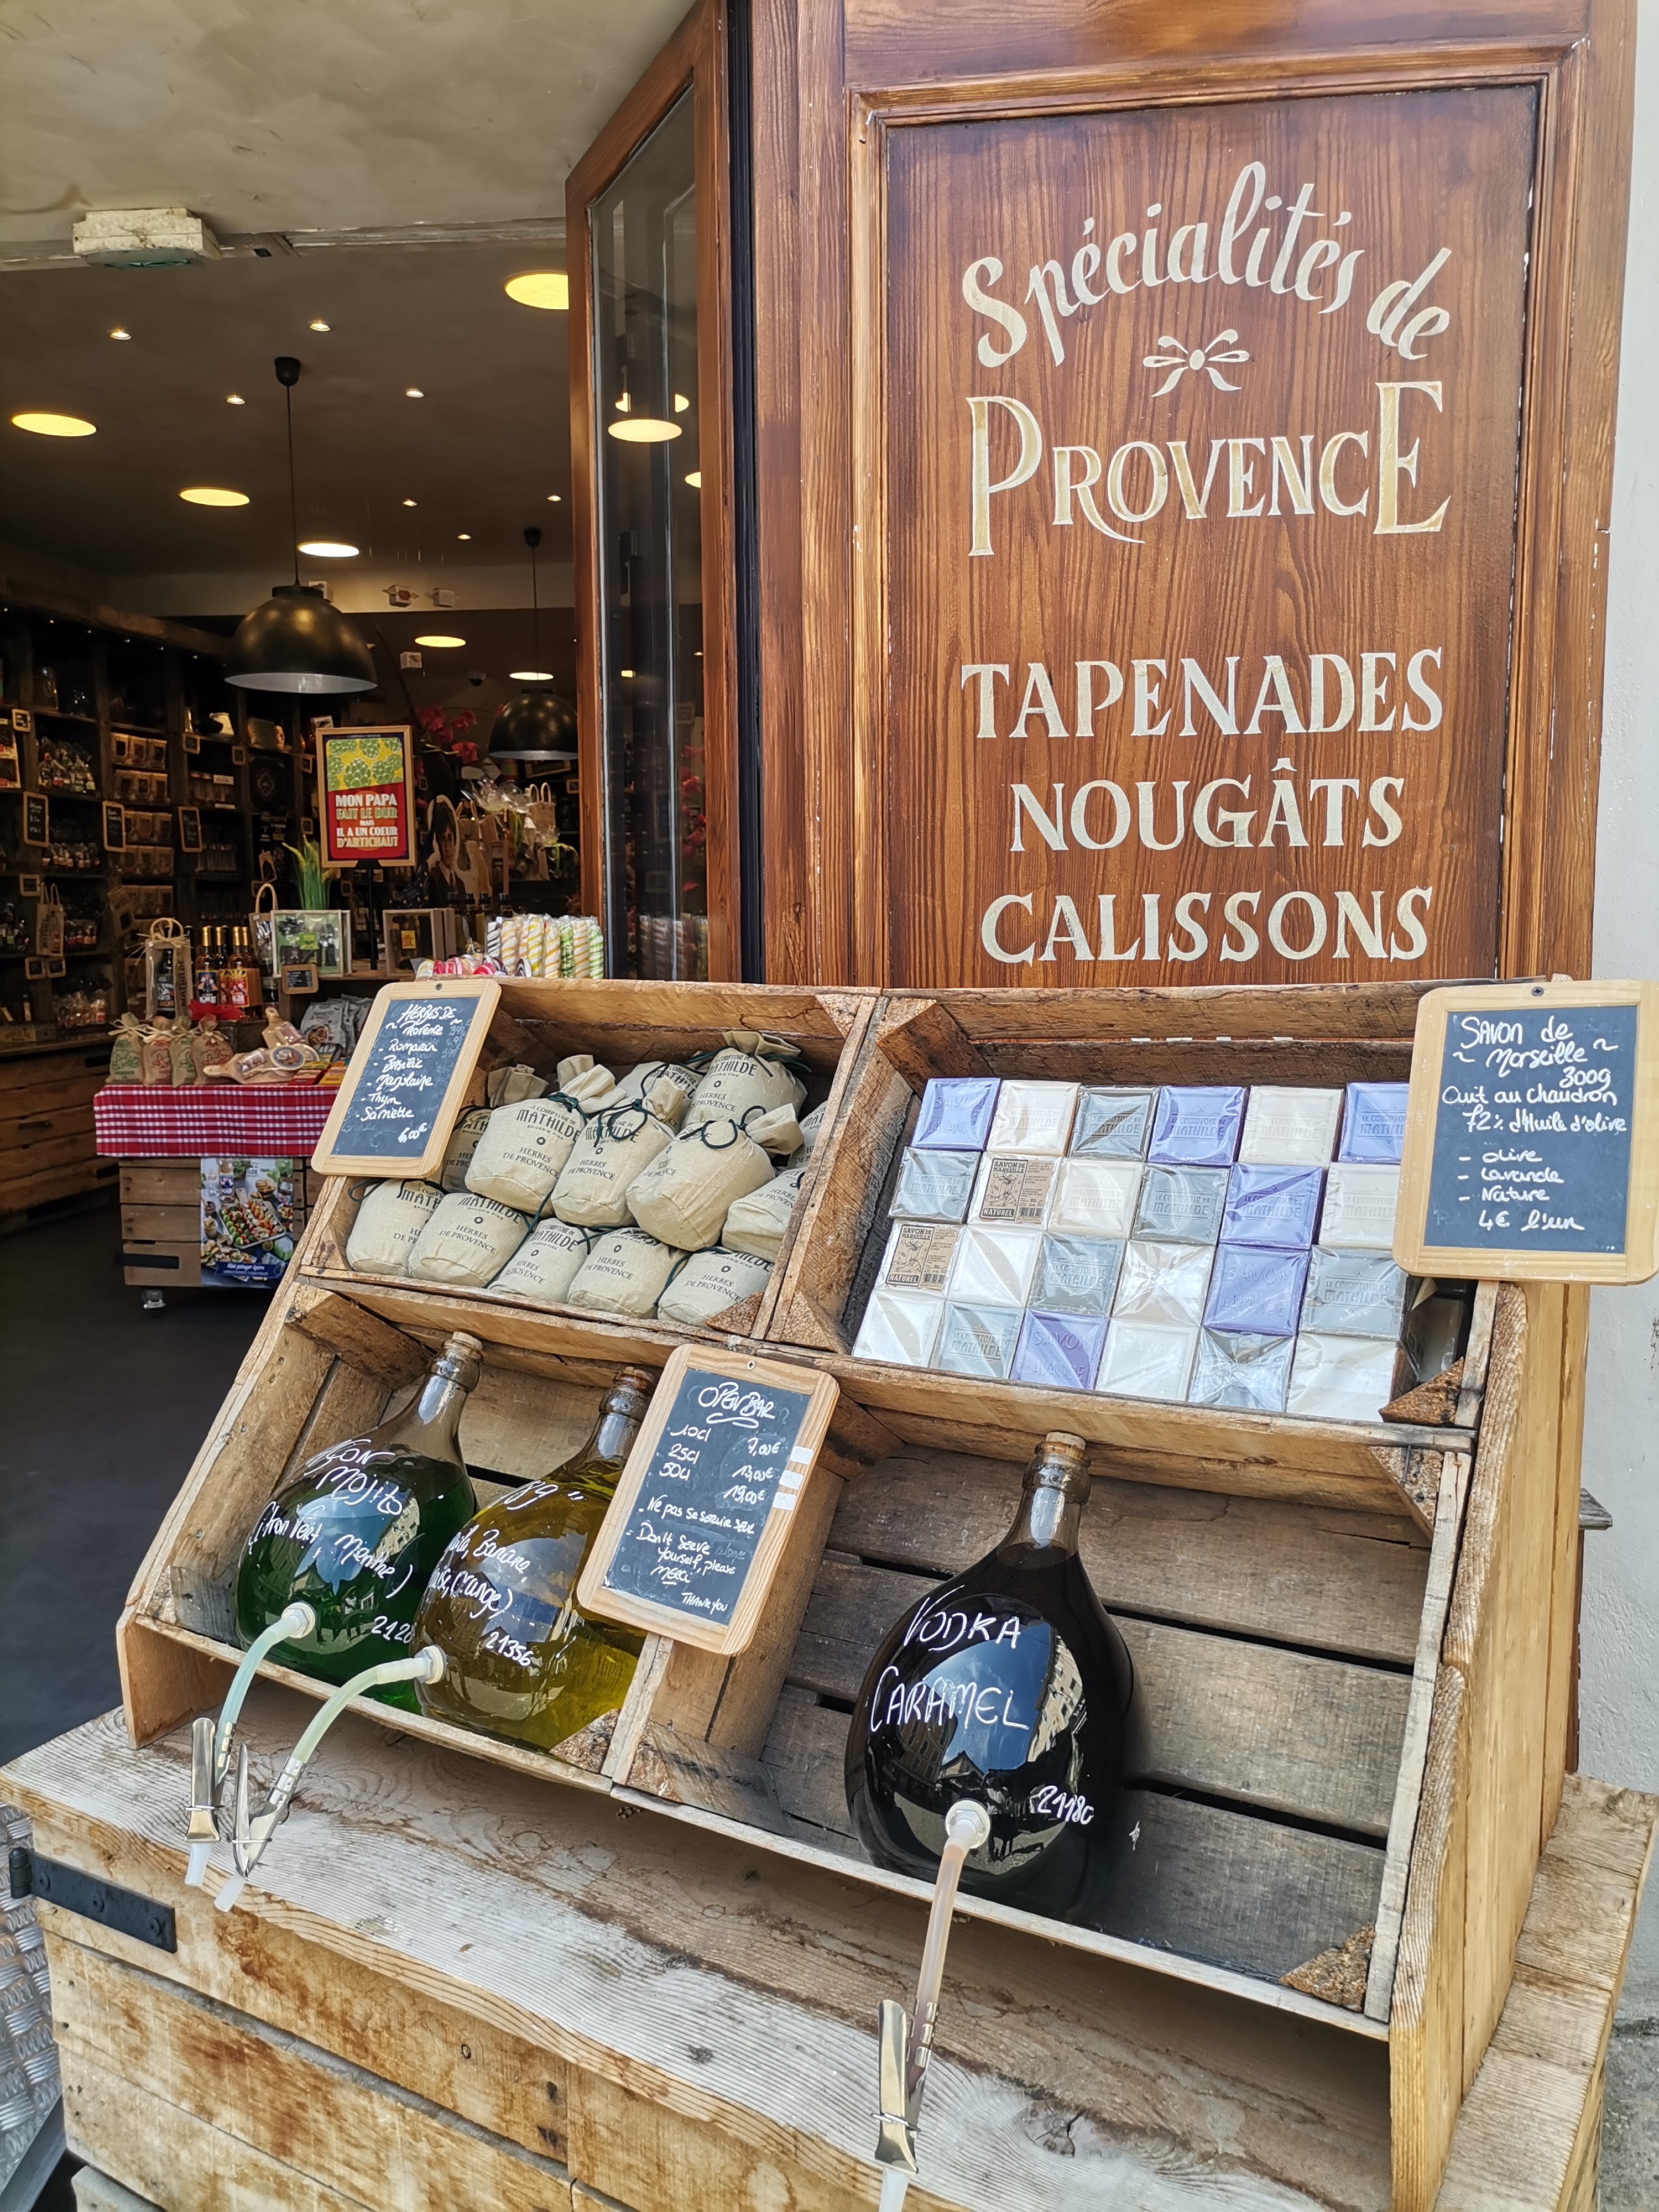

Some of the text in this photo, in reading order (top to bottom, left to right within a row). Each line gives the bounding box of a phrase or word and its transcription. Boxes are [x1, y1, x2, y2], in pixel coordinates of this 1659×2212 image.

[962, 161, 1452, 367] Spécialités de
[961, 646, 1442, 738] TAPENADES
[335, 793, 398, 807] MON PAPA
[1010, 758, 1404, 852] NOUGÂTS
[336, 807, 398, 820] FAIT LE DUR
[336, 828, 345, 837] IL
[347, 827, 354, 836] A
[355, 827, 367, 836] UN
[337, 837, 398, 848] D'ARTICHAUT
[981, 886, 1432, 966] CALISSONS
[1541, 1016, 1573, 1042] de
[1559, 1067, 1611, 1091] 300g
[368, 1091, 401, 1110] Thym
[1495, 1090, 1522, 1104] au
[516, 1109, 581, 1142] MATHILDE
[519, 1146, 552, 1163] HERBES
[580, 1159, 607, 1167] HERBES
[503, 1152, 559, 1178] DE PROVENCE
[575, 1167, 616, 1181] PROVENCE
[765, 1193, 794, 1208] PROVEN
[770, 1188, 796, 1202] HERBE
[457, 1197, 523, 1224] MATHILDE
[1343, 1206, 1395, 1217] MATHILD
[456, 1225, 489, 1240] HERBES
[451, 1232, 497, 1254] PROVENCE
[597, 1256, 625, 1267] HERBES
[593, 1265, 634, 1280] PROVENCE
[702, 1274, 735, 1287] HERBES
[1226, 1267, 1290, 1284] SAVON
[697, 1281, 742, 1302] PROVENCE
[1222, 1295, 1286, 1317] LAVANDE
[1032, 1331, 1092, 1350] SAVON
[740, 1391, 775, 1419] BAR
[661, 1504, 682, 1519] pas
[903, 1584, 1021, 1652] VODKA
[486, 1631, 534, 1667] 21356
[870, 1666, 1029, 1733] CARAMEL
